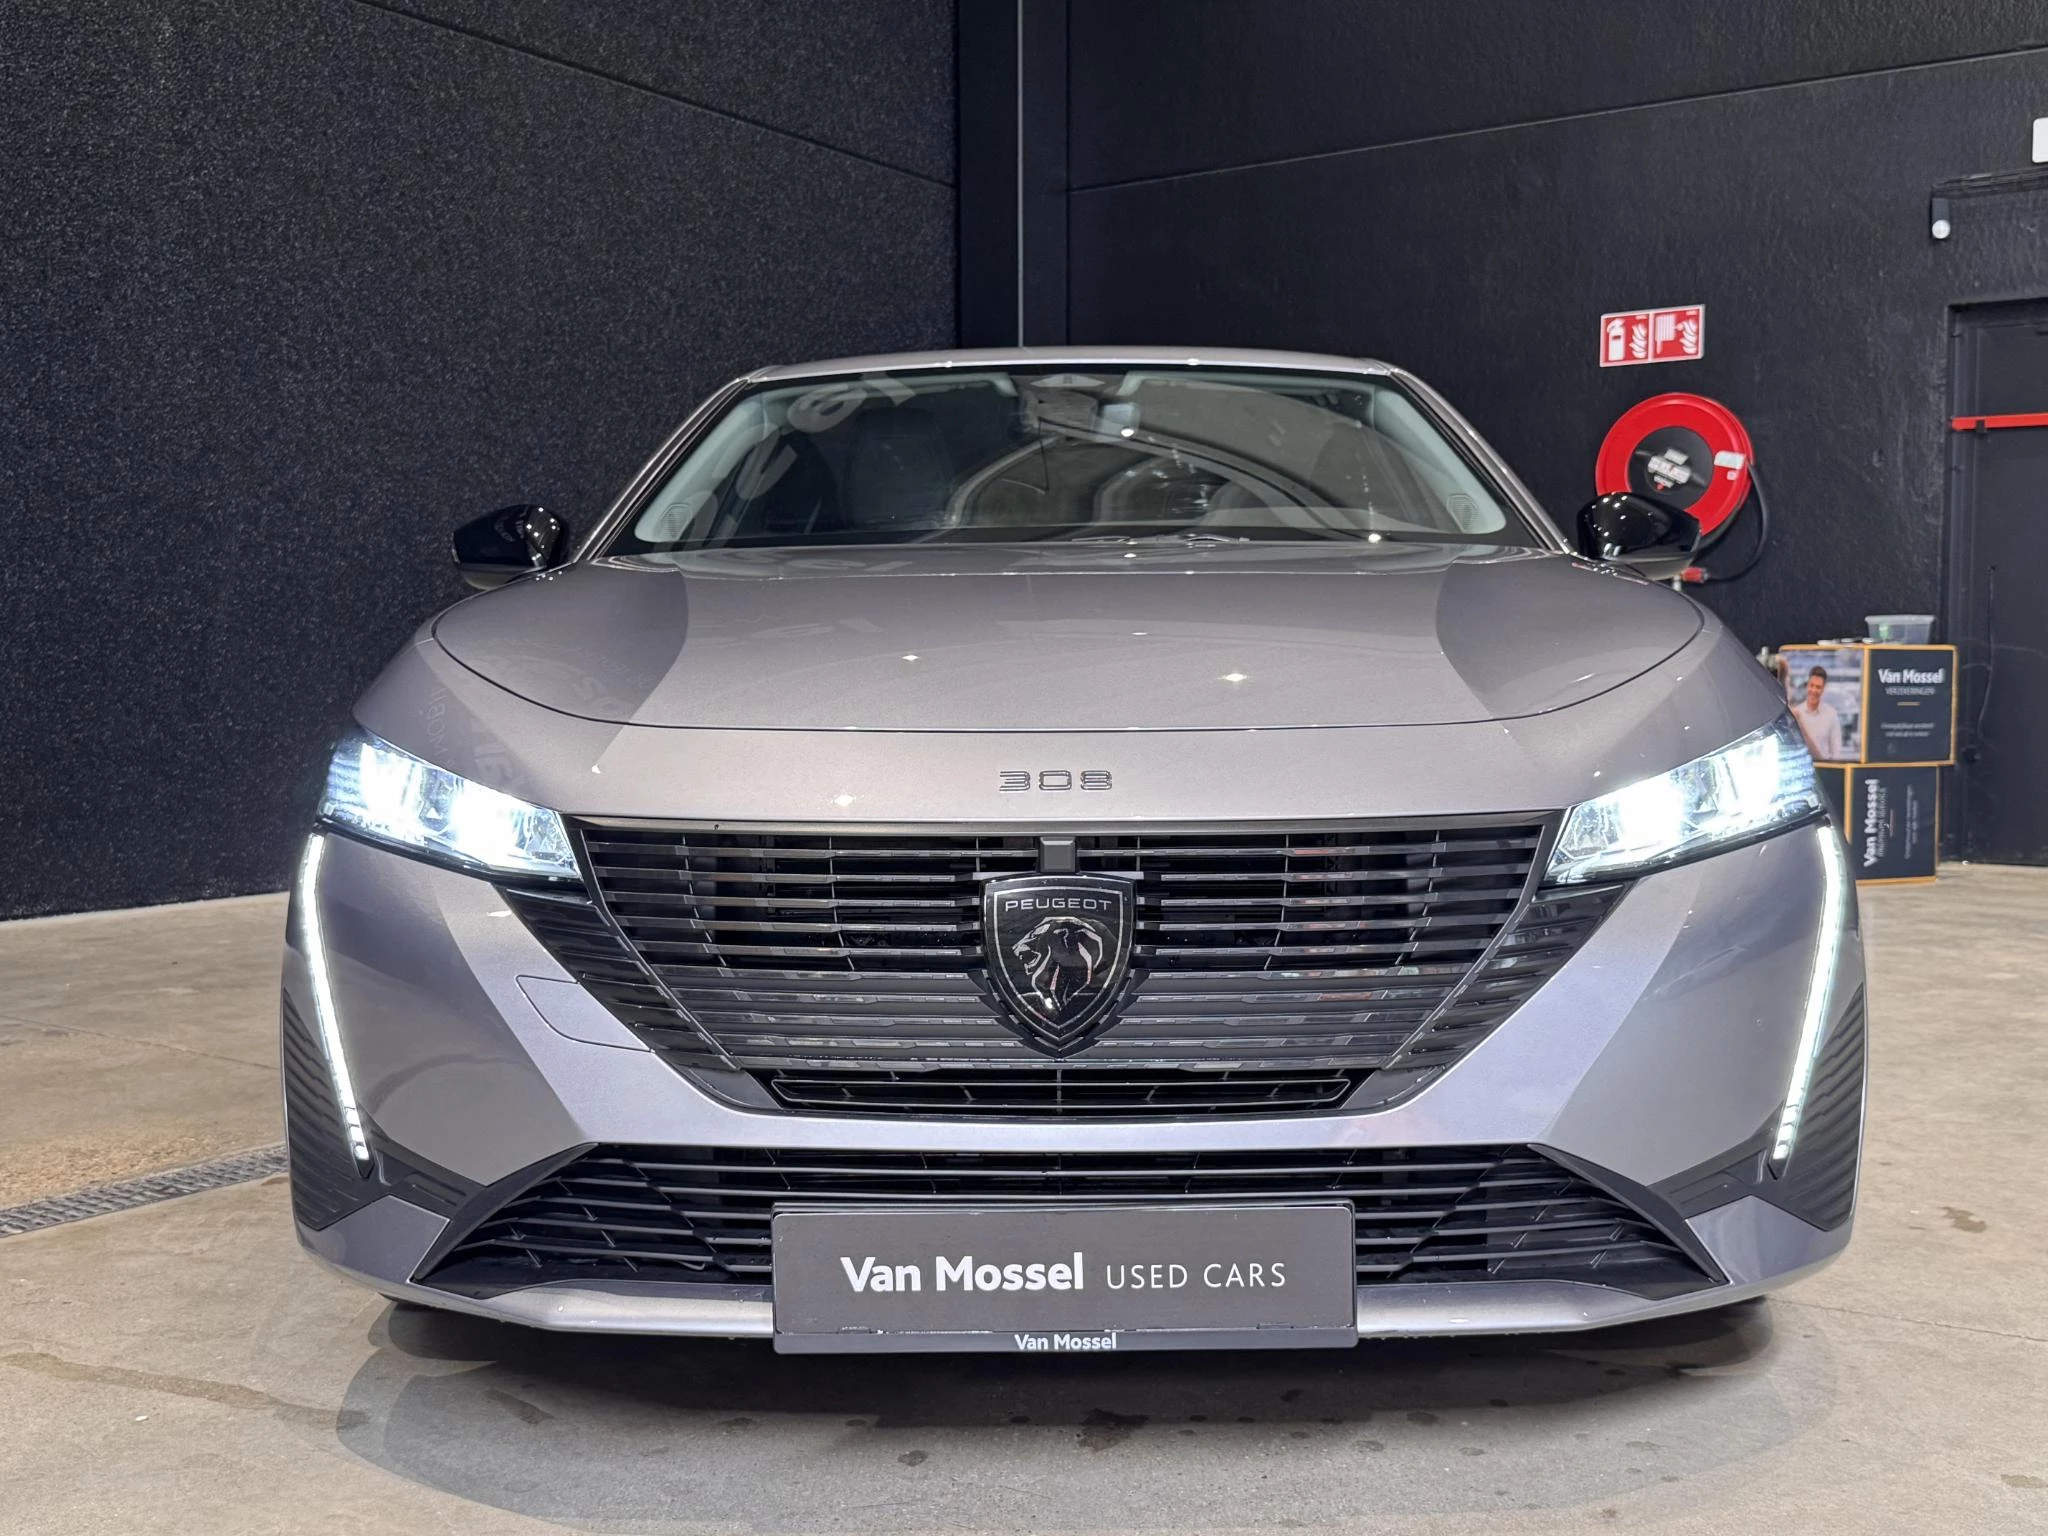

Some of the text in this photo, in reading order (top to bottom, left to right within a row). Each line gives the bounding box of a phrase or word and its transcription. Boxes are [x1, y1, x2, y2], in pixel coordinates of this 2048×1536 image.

[1878, 668, 1945, 684] Van Mossel
[999, 770, 1113, 792] 308
[1863, 778, 1880, 868] Van Mossel
[1005, 898, 1112, 912] PEUGEOT
[840, 1251, 1286, 1292] Van Mossel USED CARS
[1014, 1331, 1117, 1351] Van Mossel
